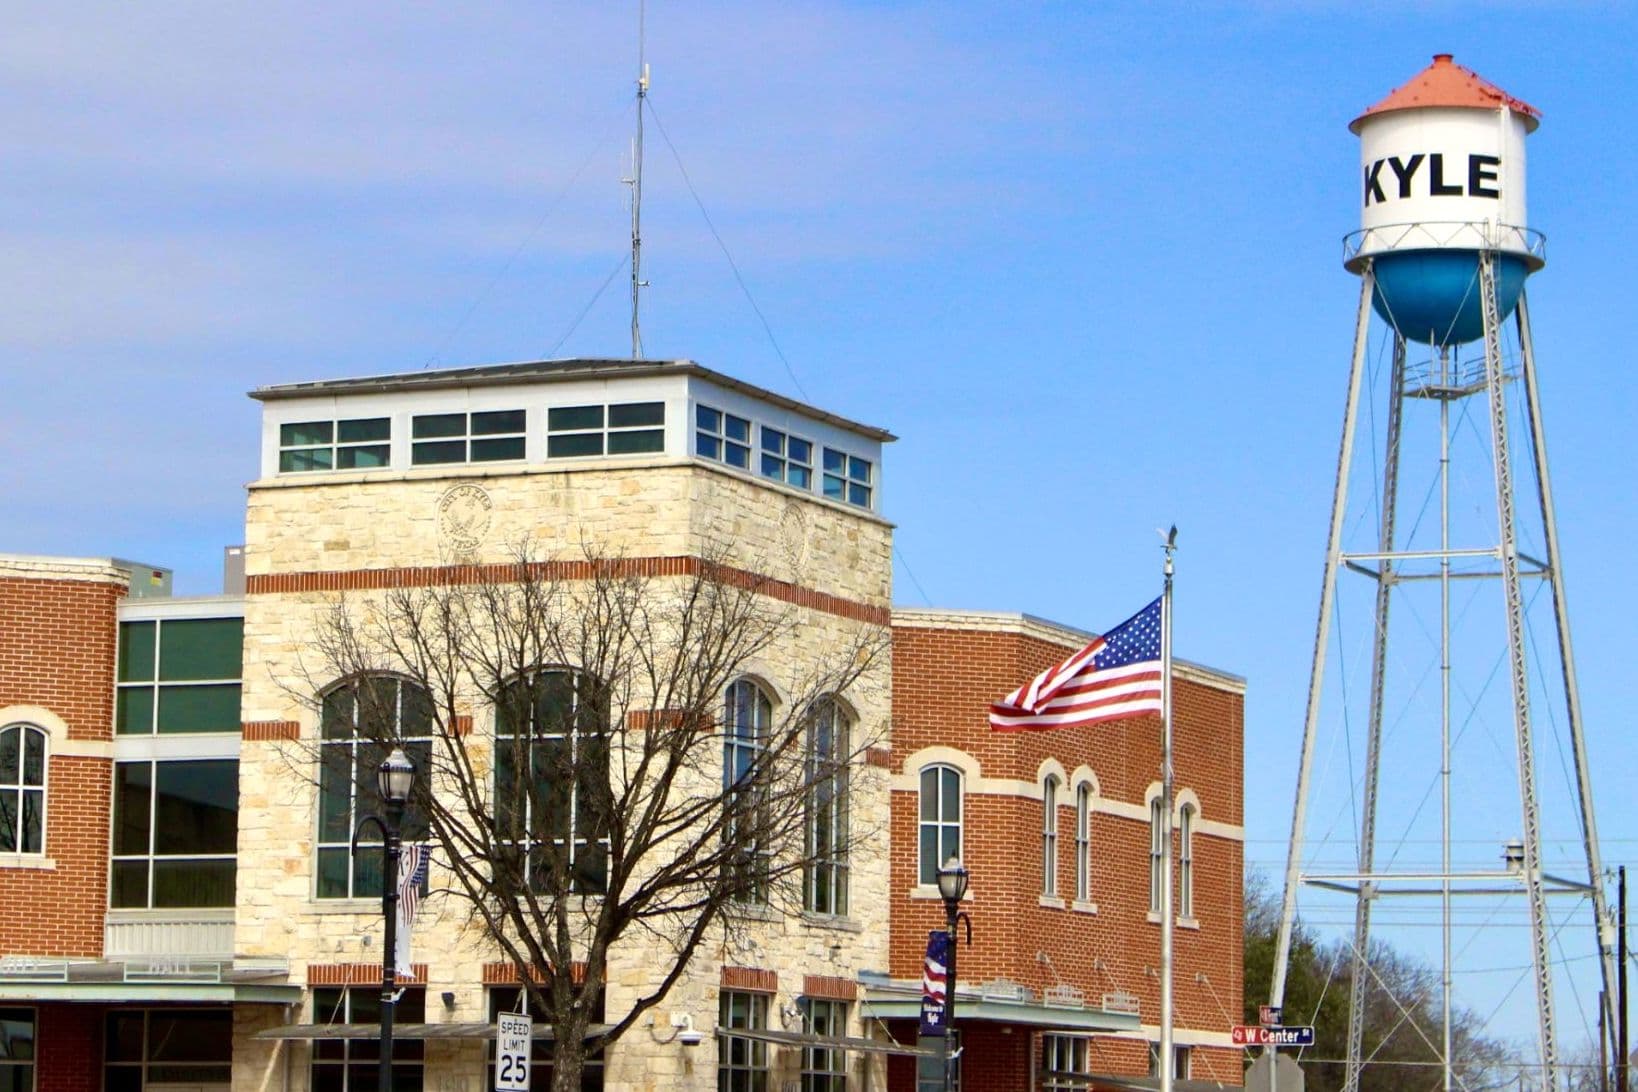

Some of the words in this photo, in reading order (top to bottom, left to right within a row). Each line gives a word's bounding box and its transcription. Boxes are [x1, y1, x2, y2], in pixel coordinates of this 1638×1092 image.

[1364, 153, 1502, 208] KYLE
[501, 1021, 529, 1036] SPEED
[1245, 1028, 1256, 1042] W
[1260, 1028, 1299, 1042] Center
[503, 1039, 526, 1052] LIMIT
[500, 1054, 527, 1083] 25
